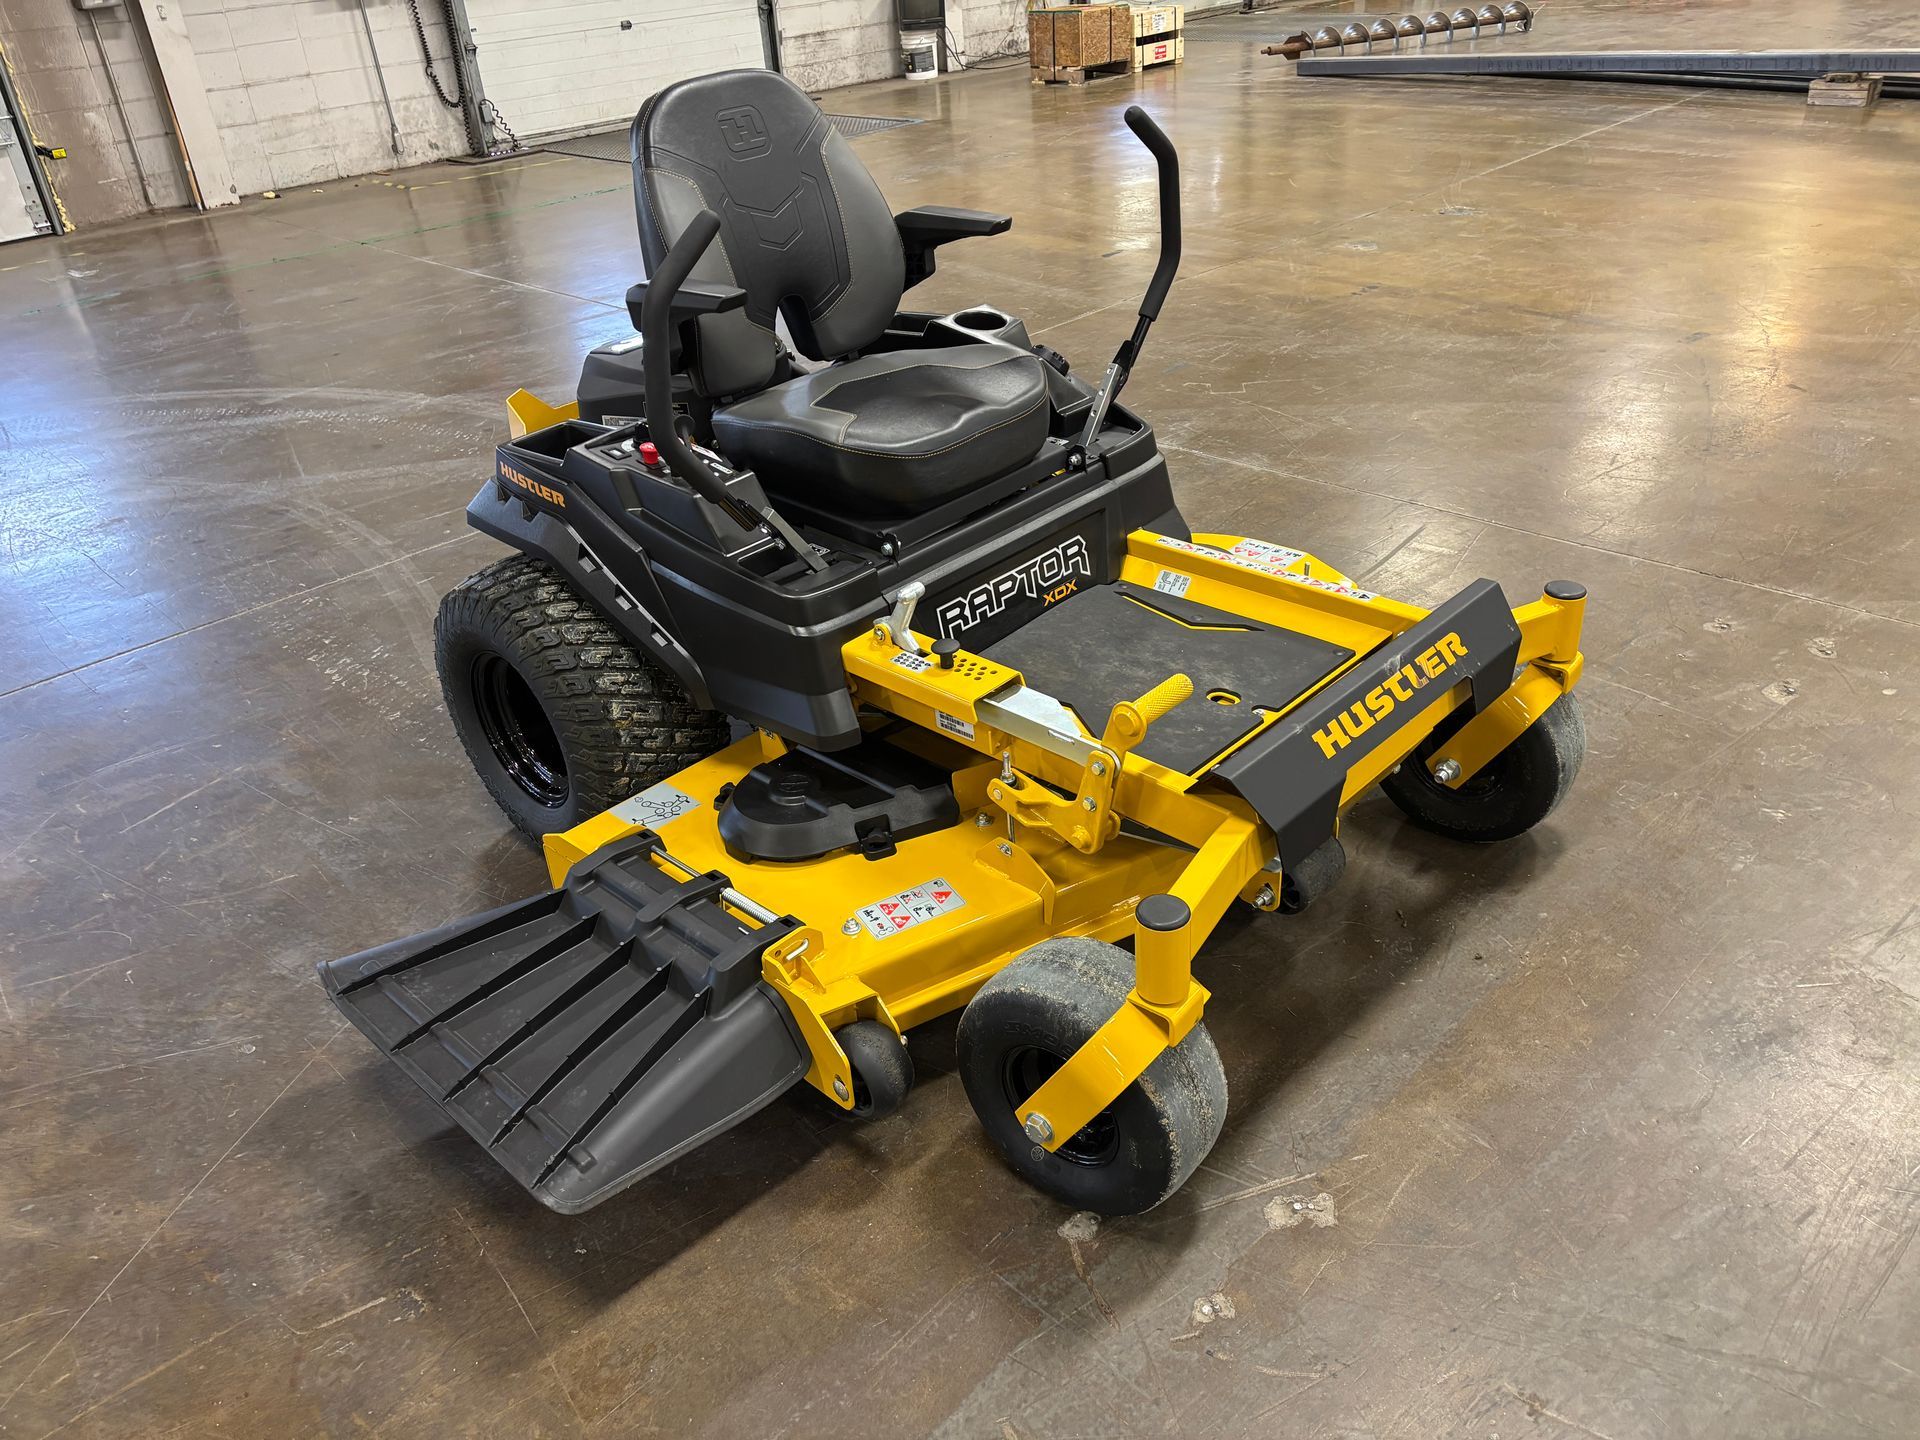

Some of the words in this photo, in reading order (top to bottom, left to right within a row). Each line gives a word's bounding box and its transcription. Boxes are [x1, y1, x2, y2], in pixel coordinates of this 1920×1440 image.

[1720, 58, 1752, 70] USA
[1771, 57, 1829, 70] STEEL
[1847, 57, 1897, 70] NOVA
[499, 461, 566, 508] HUSTLER
[936, 535, 1091, 640] RAPTOR
[1042, 579, 1078, 607] XDX
[1311, 632, 1469, 759] HUSTLER
